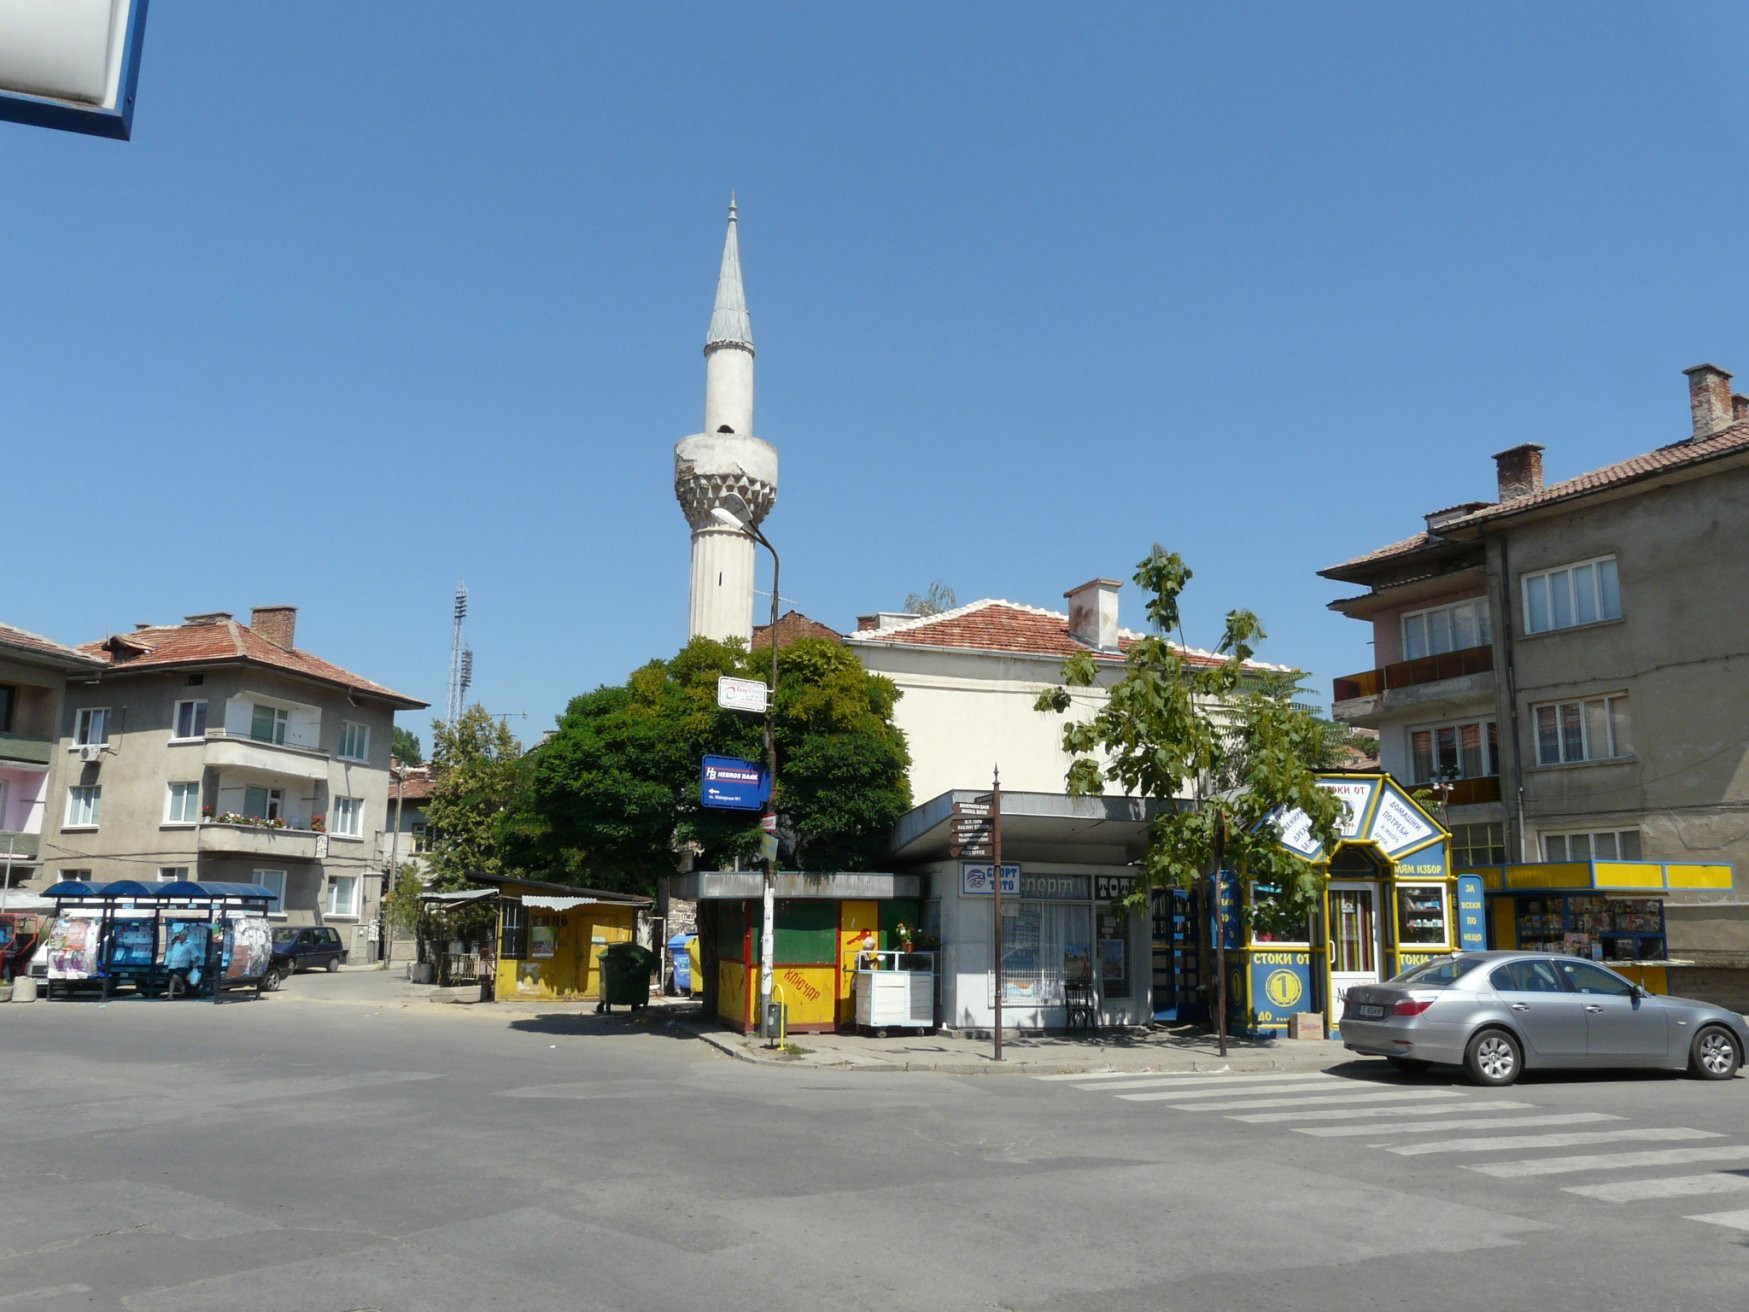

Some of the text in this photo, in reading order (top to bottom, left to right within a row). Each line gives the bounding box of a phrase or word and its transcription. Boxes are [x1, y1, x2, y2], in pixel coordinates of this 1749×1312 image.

[718, 771, 759, 781] HEBROS BANK
[1326, 785, 1366, 795] ТОКИ ОТ
[1388, 801, 1422, 833] ДОМАШНИ
[1382, 810, 1410, 837] ПОТРЕБИ
[987, 867, 1017, 878] СОРТ
[1416, 865, 1442, 875] ИЗБОР
[990, 880, 1014, 891] ТТО
[1465, 884, 1475, 893] ЗА
[1466, 916, 1477, 925] ПО
[1463, 933, 1482, 942] НЕЩО
[1253, 953, 1293, 965] СТОКИ
[1400, 953, 1429, 966] ТОКИ
[783, 967, 821, 1002] КЛЮЧАР
[1276, 975, 1288, 998] 1
[1258, 1011, 1273, 1022] ДО
